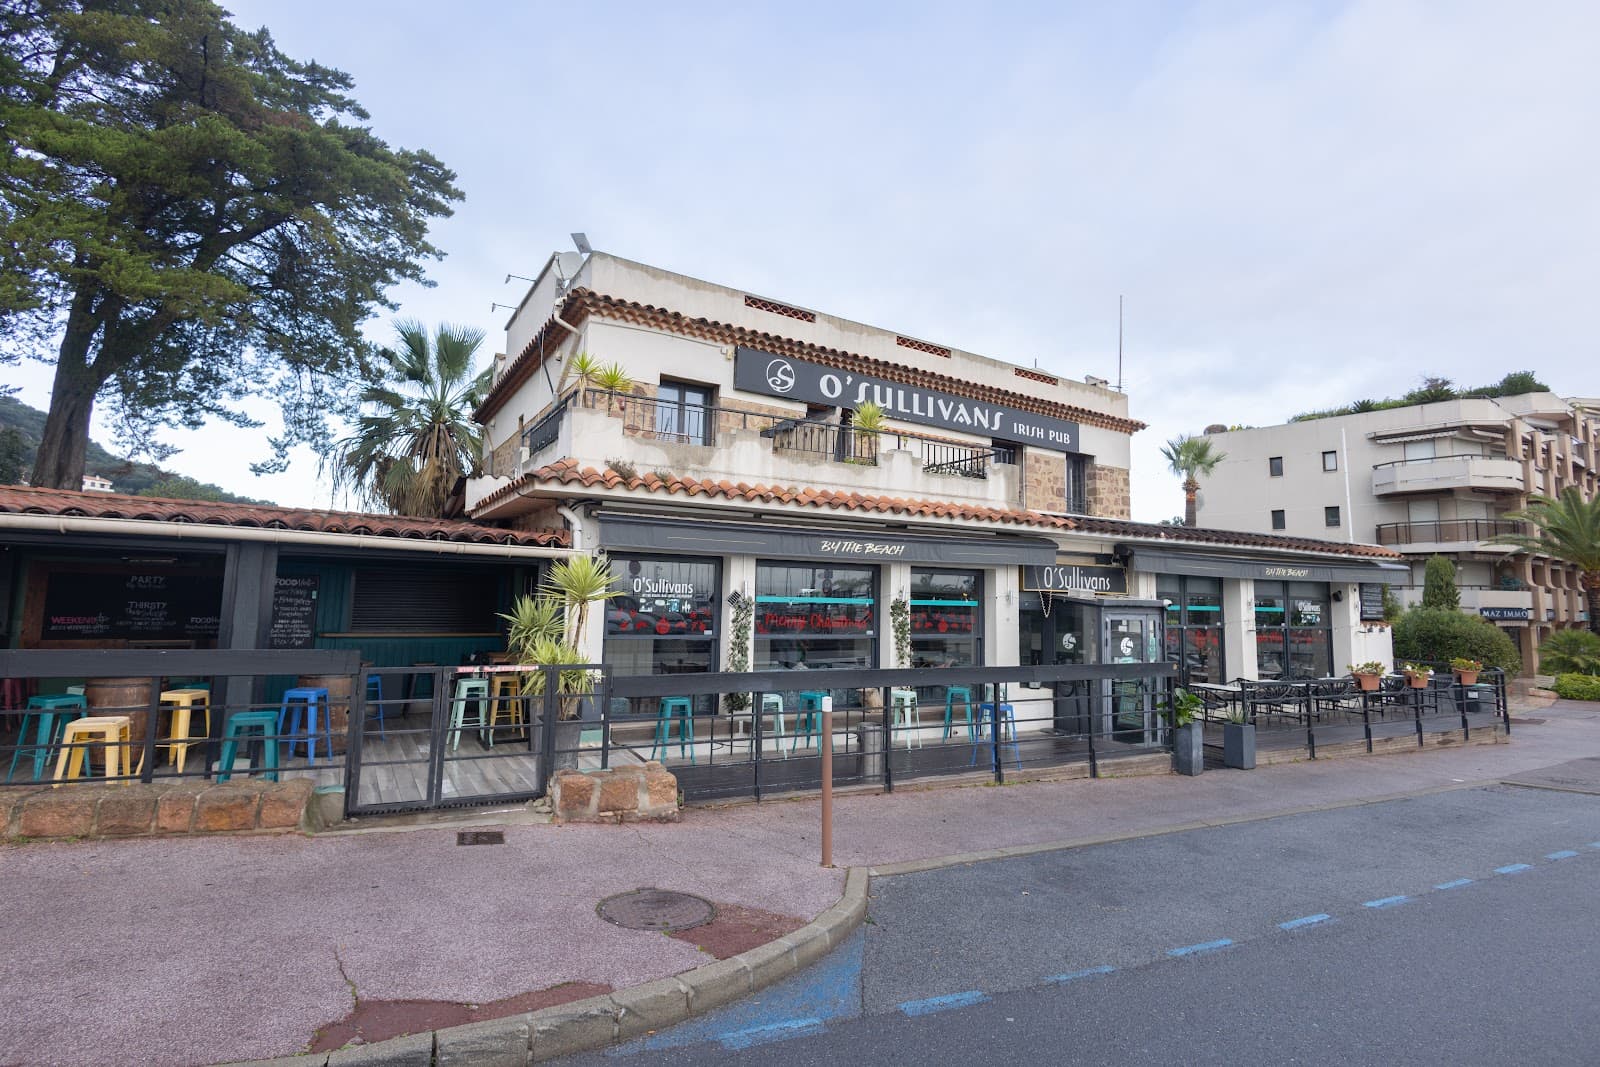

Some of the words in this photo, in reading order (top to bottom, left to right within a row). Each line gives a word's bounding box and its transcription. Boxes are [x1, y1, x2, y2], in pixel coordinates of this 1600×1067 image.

[819, 374, 1004, 431] O'SULLIVANS
[1013, 422, 1044, 439] IRISH
[1049, 430, 1070, 444] PUB
[820, 541, 841, 555] BY
[841, 541, 863, 553] THE
[864, 543, 905, 555] BEACH
[633, 577, 693, 594] O'Sullivans
[1044, 566, 1110, 590] O'Sullivans
[1504, 610, 1528, 618] IMMO
